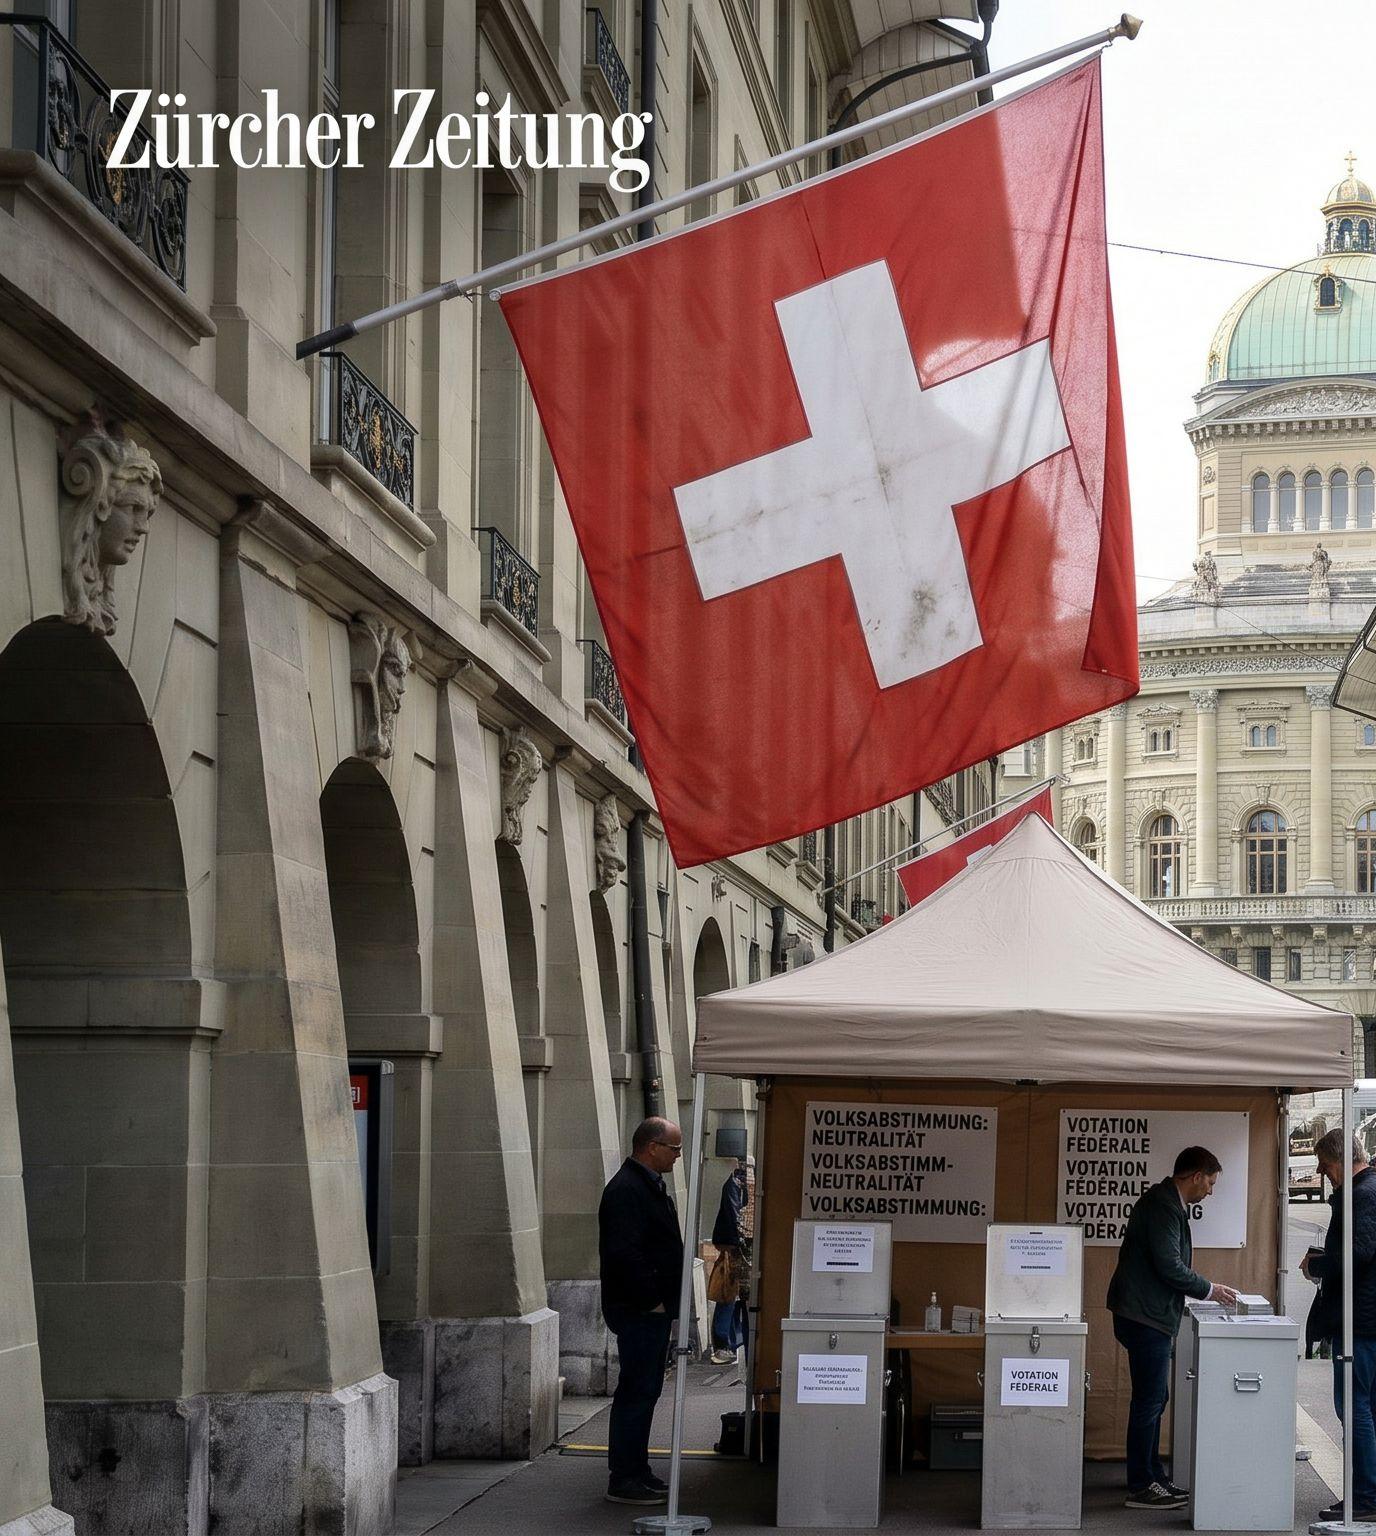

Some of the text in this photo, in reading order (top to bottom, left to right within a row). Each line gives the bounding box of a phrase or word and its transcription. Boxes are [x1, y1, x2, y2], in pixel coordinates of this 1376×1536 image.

[813, 1109, 988, 1130] VOLKSABSTIMMUNG:
[1067, 1117, 1148, 1134] VOTATION
[812, 1130, 926, 1149] NEUTRALITÄT
[811, 1153, 954, 1173] VOLKSABSTIMM-
[1066, 1159, 1147, 1177] VOTATION
[810, 1173, 925, 1192] NEUTRALITÄT
[809, 1196, 986, 1217] VOLKSABSTIMMUNG:
[1064, 1202, 1134, 1219] VOTATIO
[1011, 1370, 1059, 1380] VOTATION
[1010, 1382, 1059, 1392] FEDERALE
